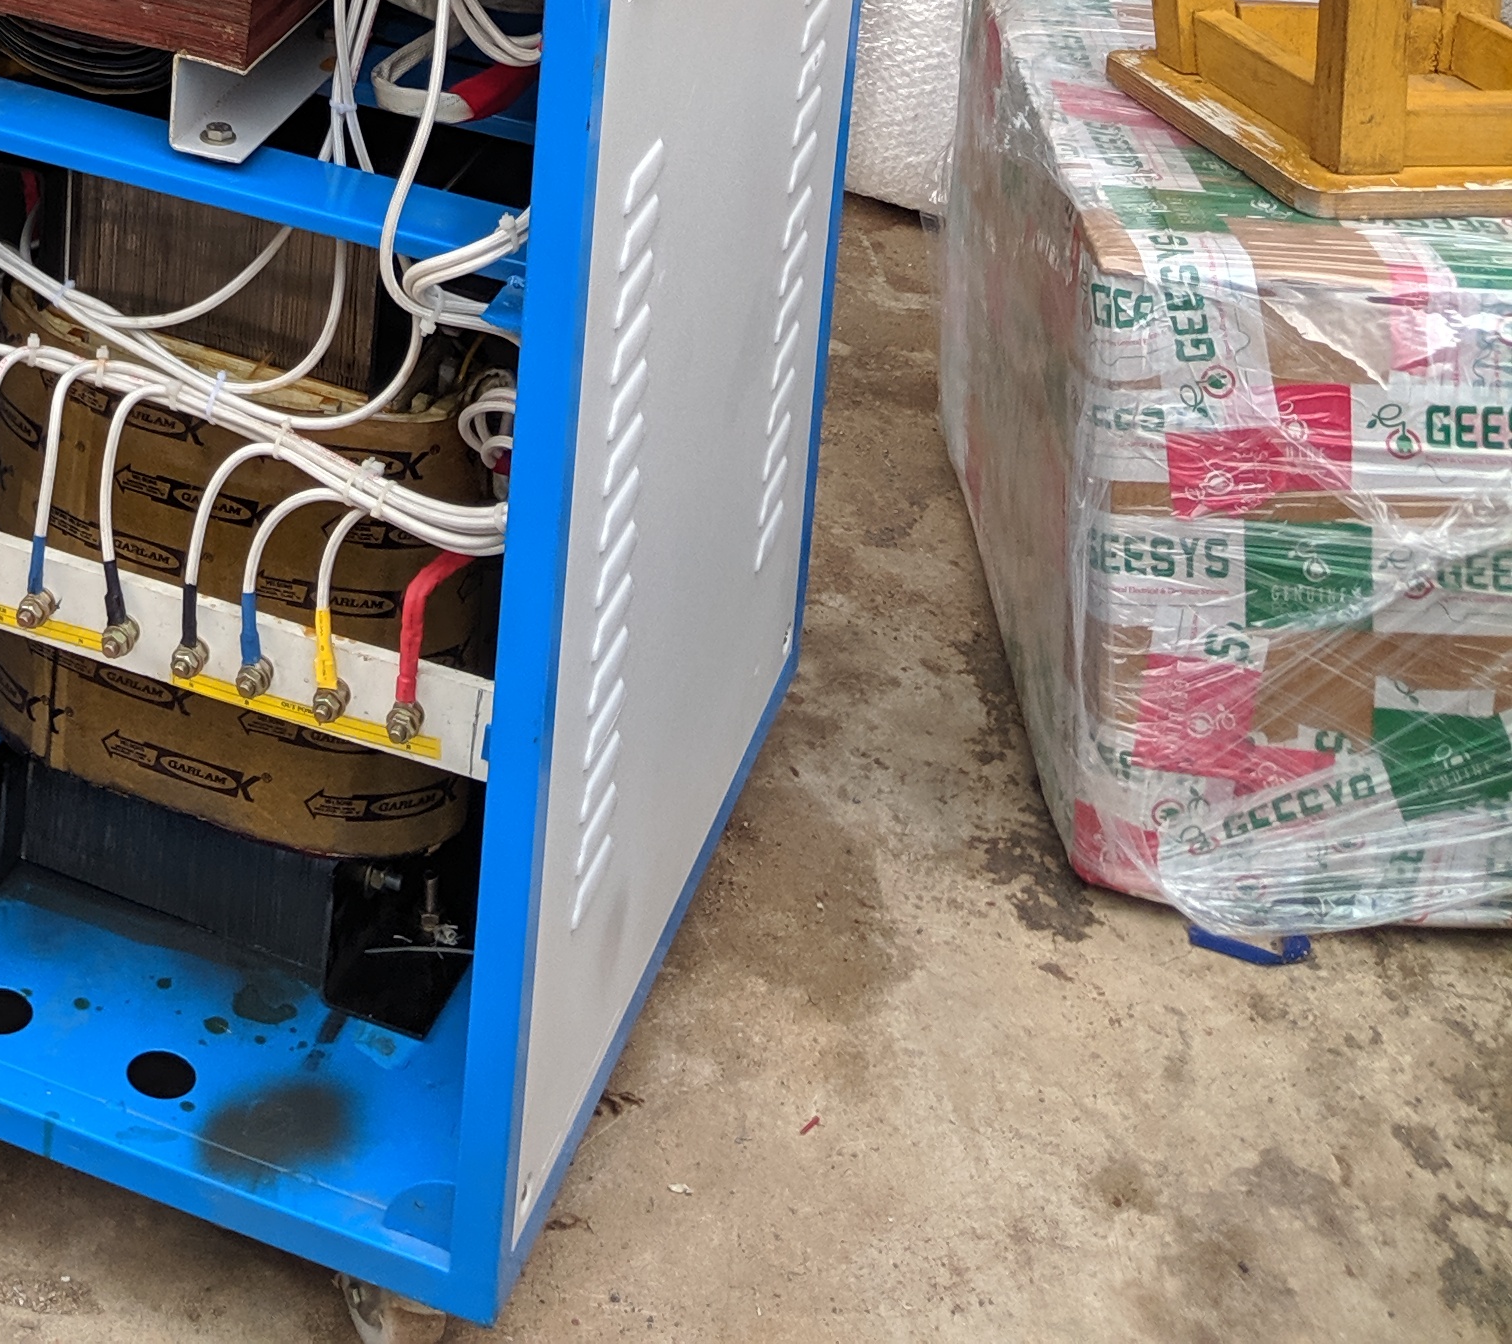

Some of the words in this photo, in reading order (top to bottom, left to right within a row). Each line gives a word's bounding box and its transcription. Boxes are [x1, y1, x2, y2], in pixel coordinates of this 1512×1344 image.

[129, 409, 177, 430] ARLAM
[1426, 405, 1512, 449] GEE
[181, 492, 243, 516] GAAM
[330, 595, 386, 611] ARLAM
[168, 758, 228, 786] GARLAM
